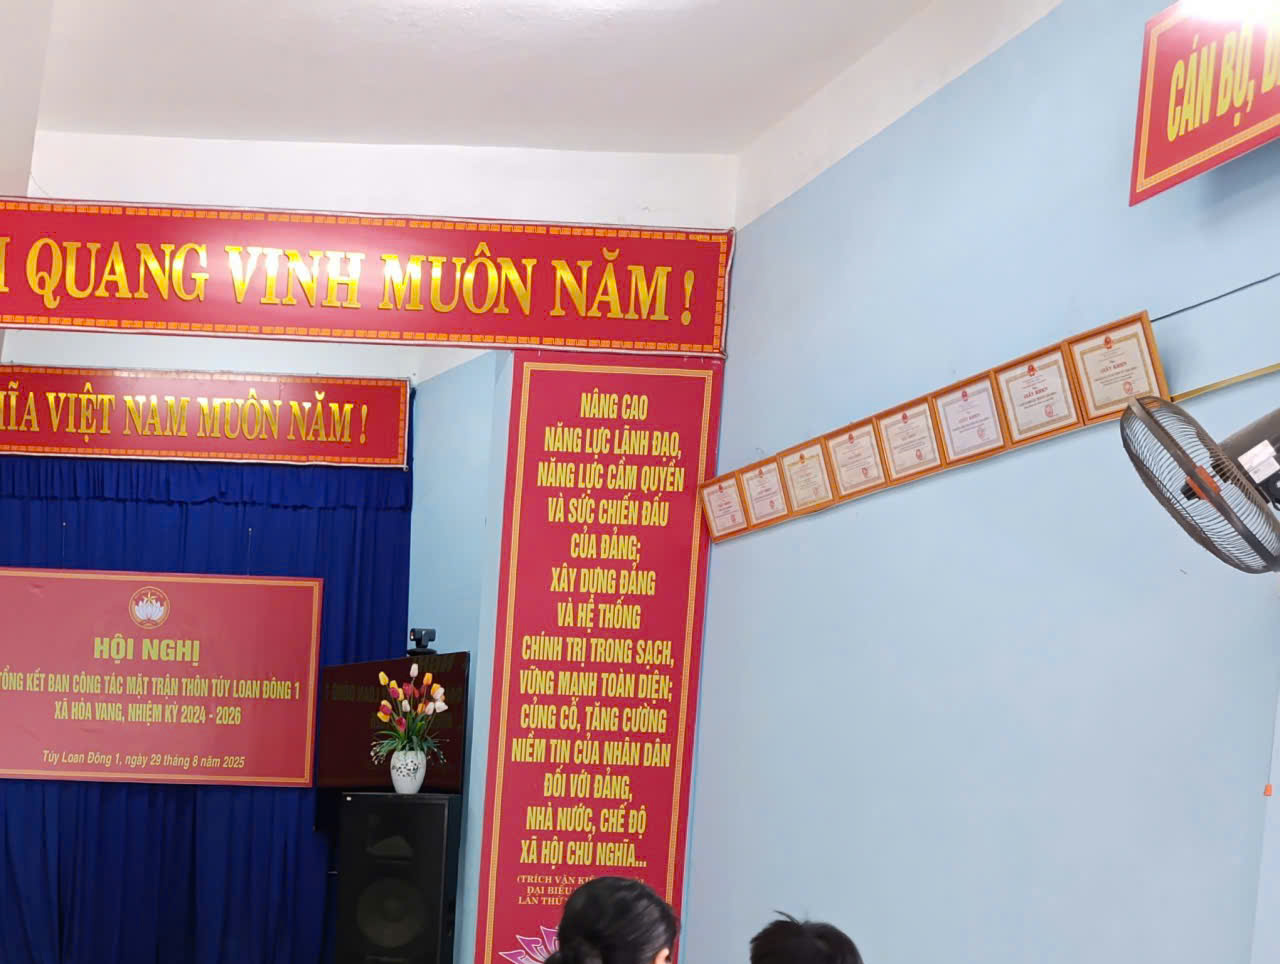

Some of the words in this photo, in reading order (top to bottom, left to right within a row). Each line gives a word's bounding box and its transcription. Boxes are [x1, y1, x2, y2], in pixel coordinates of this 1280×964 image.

[1167, 32, 1217, 142] CÁN
[26, 236, 209, 310] QUANG
[222, 244, 363, 310] VINH
[380, 241, 533, 316] MUÔN
[46, 381, 116, 444] VIỆT
[124, 390, 189, 438] NAM
[196, 385, 280, 440] MUÔN
[580, 388, 618, 419] NÂNG
[621, 394, 649, 421] CAO
[544, 421, 582, 453] NĂNG
[585, 426, 610, 459] LỰC
[614, 425, 649, 456] LÃNH
[652, 431, 682, 462] ĐẠO,
[548, 489, 565, 523] VÀ
[568, 493, 595, 524] SỨC
[598, 491, 639, 526] CHIẾN
[641, 491, 670, 527] ĐẤU
[557, 597, 574, 627] VÀ
[577, 596, 595, 633] HỆ
[598, 595, 641, 630] THỐNG
[94, 633, 134, 664] HỘI
[142, 638, 200, 667] NGHỊ
[26, 668, 46, 692] KẾT
[48, 673, 70, 693] BAN
[73, 671, 101, 694] CÔNG
[104, 672, 123, 694] TÁC
[126, 672, 149, 700] MẶT
[152, 673, 179, 700] TRẬN
[181, 674, 209, 697] THÔN
[233, 680, 260, 699] LOAN
[262, 676, 292, 700] ĐÔNG
[294, 681, 300, 700] 1
[520, 665, 555, 695] VỮNG
[601, 667, 635, 697] TOÀN
[54, 697, 69, 720] XÃ
[128, 699, 162, 727] NHIỆM
[180, 705, 206, 724] 2024
[216, 706, 241, 725] 2026
[62, 751, 85, 764] Loan
[87, 752, 112, 768] Đông
[125, 754, 148, 769] ngày
[150, 753, 162, 766] 29
[163, 753, 190, 770] tháng
[192, 756, 198, 767] 8
[200, 756, 221, 768] năm
[222, 756, 246, 769] 2025
[512, 730, 546, 762] NIỀM
[550, 739, 571, 763] TIN
[573, 731, 600, 765] CỦA
[604, 737, 639, 766] NHÂN
[643, 737, 671, 767] DÂN
[544, 765, 566, 797] ĐỐI
[570, 768, 591, 798] VỚI
[594, 767, 632, 802] ĐẢNG,
[526, 801, 553, 831] NHÀ
[557, 806, 596, 835] NƯỚC,
[600, 803, 626, 834] CHẾ
[628, 806, 647, 840] ĐỘ
[520, 836, 537, 864] XÃ
[541, 839, 564, 870] HỘI
[566, 834, 595, 866] CHỦ
